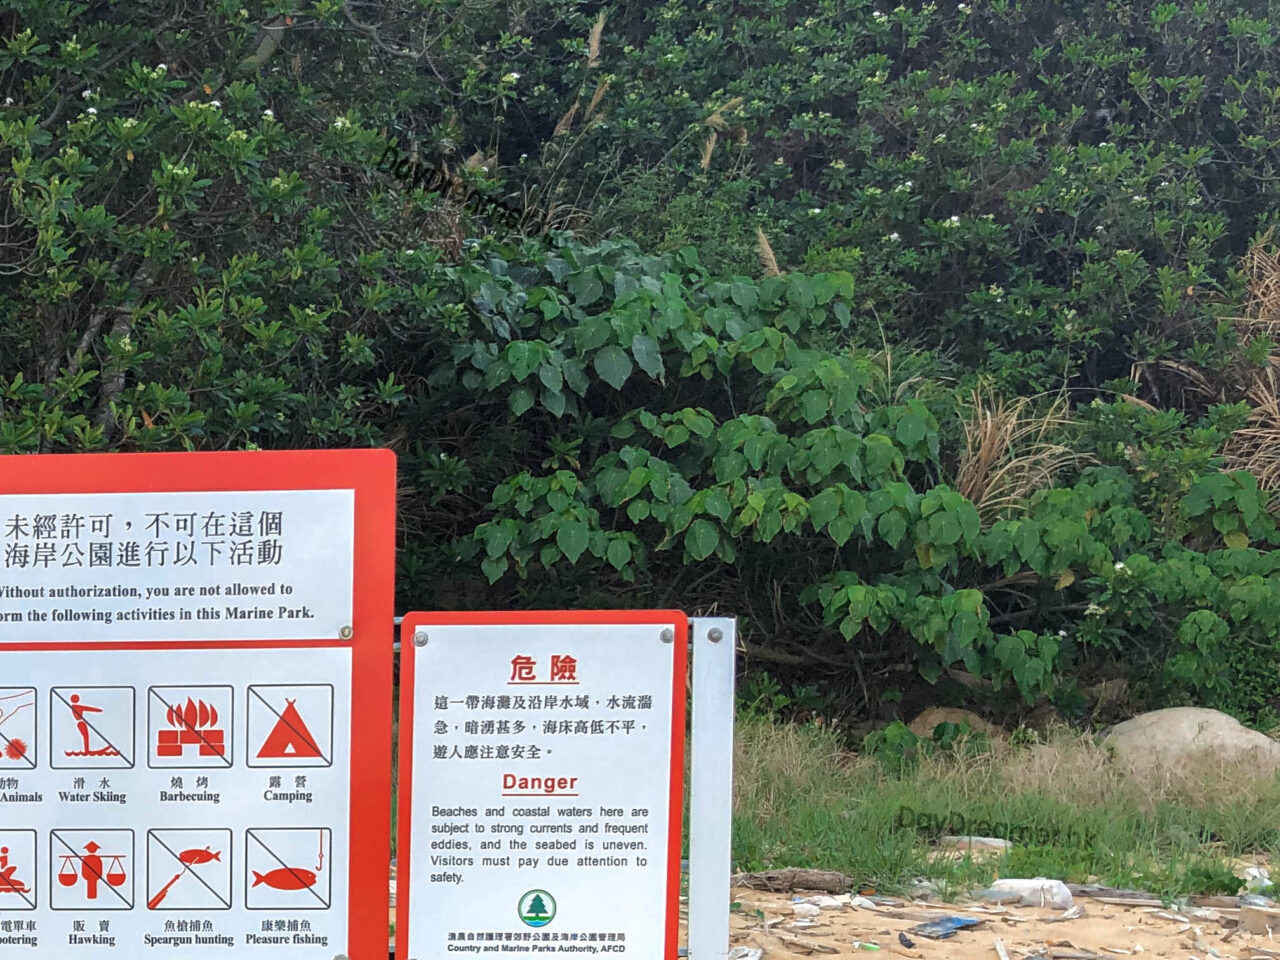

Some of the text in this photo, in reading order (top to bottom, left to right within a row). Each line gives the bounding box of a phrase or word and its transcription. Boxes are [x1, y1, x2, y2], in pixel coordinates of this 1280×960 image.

[4, 510, 282, 540] 未經許可，不可在這個
[4, 538, 282, 568] 海岸公園進行以下活動
[48, 584, 142, 600] authorization,
[145, 587, 169, 600] you
[173, 586, 195, 596] are
[199, 584, 220, 596] not
[224, 582, 275, 595] allowed
[279, 583, 293, 595] to
[27, 609, 47, 622] the
[51, 608, 112, 625] following
[116, 607, 175, 621] activities
[179, 607, 191, 620] in
[196, 606, 220, 620] this
[224, 606, 273, 619] Marine
[278, 605, 314, 619] Park.
[432, 743, 552, 760] 遊人應注意安全。
[503, 773, 578, 793] Danger
[0, 791, 43, 802] Animals
[58, 790, 126, 805] Water Skiing
[159, 789, 220, 805] Barbecuing
[263, 788, 312, 804] Camping
[431, 805, 648, 817] Beaches and coastal waters here are
[431, 821, 648, 836] subject to strong currents and frequent
[430, 838, 647, 851] eddies, and the seabed is uneven.
[430, 855, 647, 868] Visitors must pay due attention to
[430, 871, 463, 885] safety.
[164, 918, 213, 932] 魚槍捕魚
[261, 918, 311, 932] 康樂捕魚
[68, 932, 115, 948] Hawking
[143, 933, 234, 947] Speargun hunting
[245, 933, 328, 947] Pleasure fishing
[447, 943, 625, 954] Country and Marine Parks Authority, AFCD
